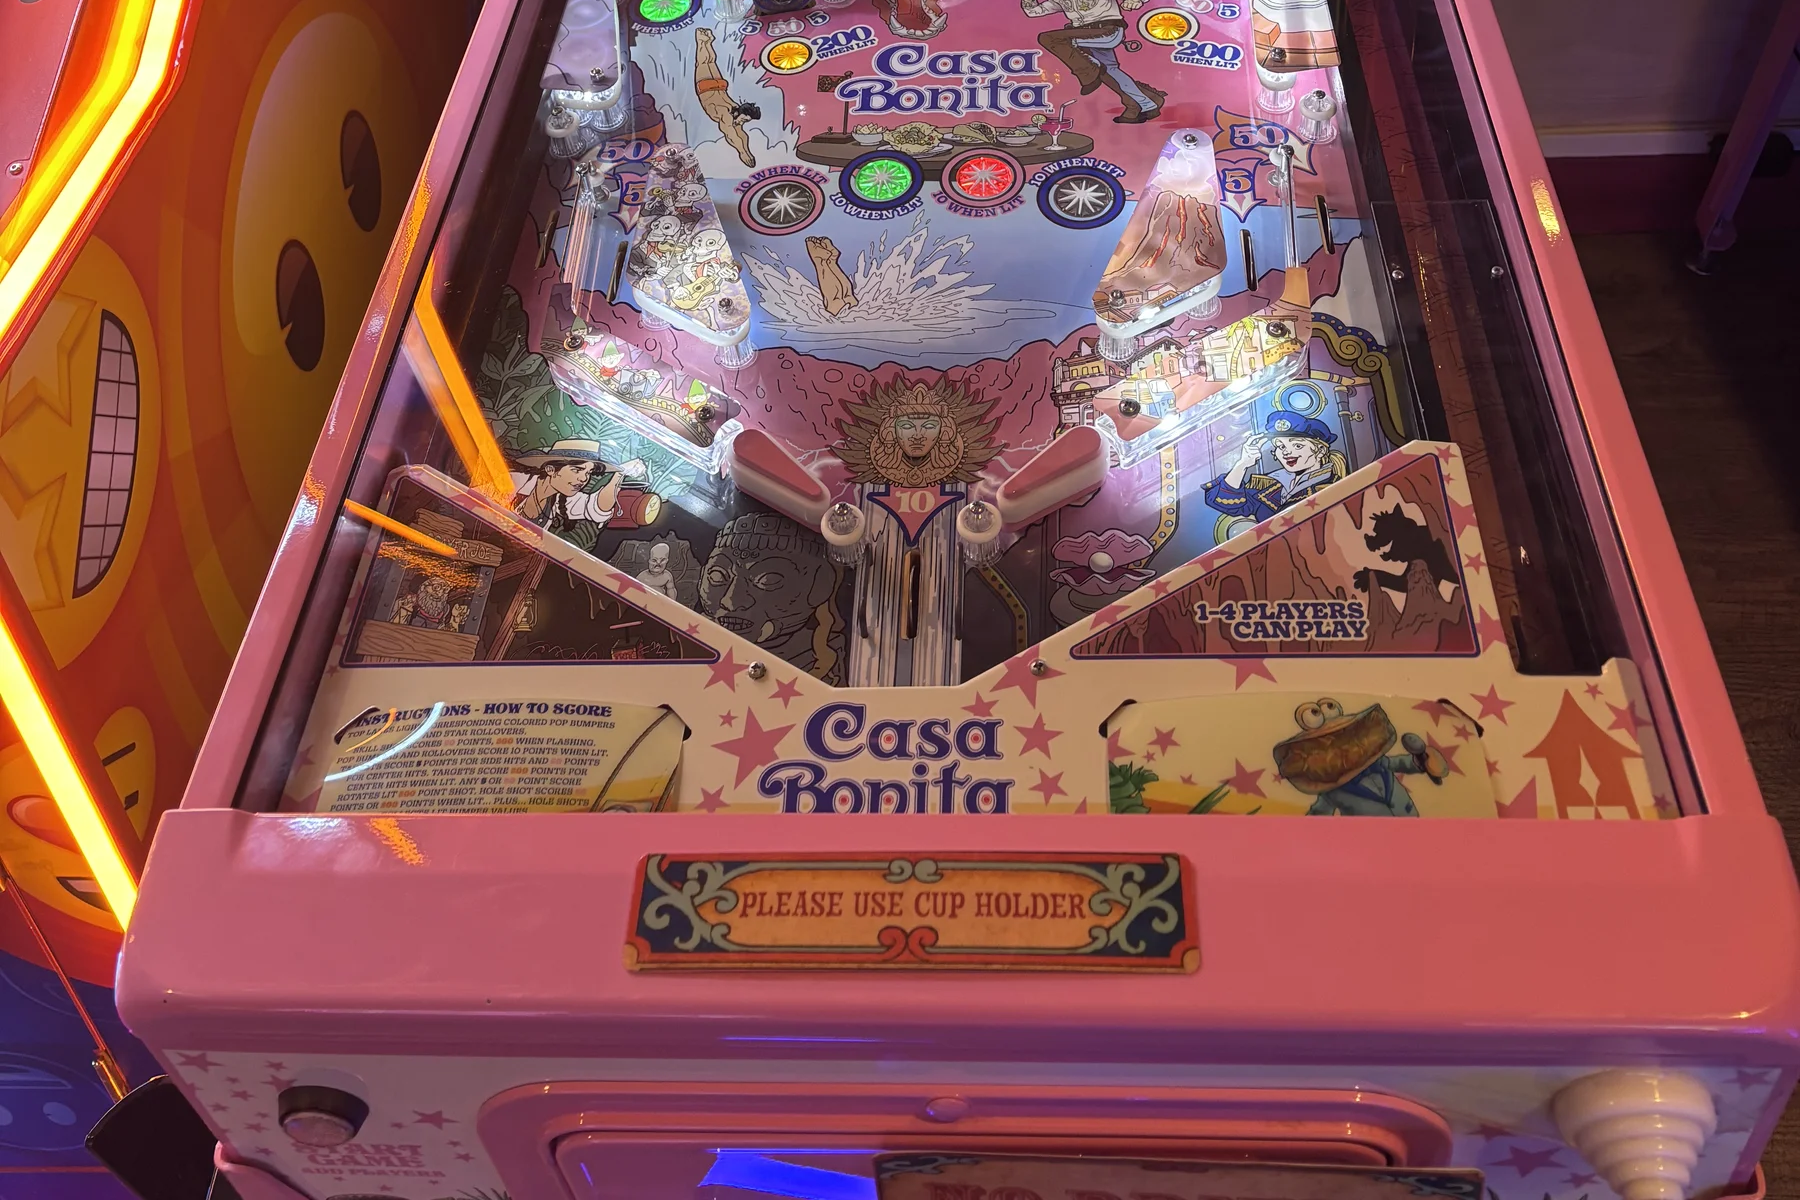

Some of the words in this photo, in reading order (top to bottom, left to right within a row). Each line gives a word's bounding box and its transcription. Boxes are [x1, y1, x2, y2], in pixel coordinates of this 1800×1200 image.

[807, 12, 829, 26] 5
[1217, 3, 1241, 18] 5
[631, 21, 670, 35] WHEN
[670, 17, 695, 32] LIT
[740, 19, 762, 34] 5
[768, 19, 805, 36] 50
[811, 26, 875, 53] 200
[816, 45, 858, 61] WHEN
[855, 38, 877, 52] LIT
[874, 44, 1041, 77] Casa
[1175, 40, 1242, 61] 200
[1173, 54, 1214, 66] WHEN
[1215, 59, 1240, 69] LIT
[836, 75, 1051, 116] Bonita
[1231, 125, 1288, 148] 50
[598, 140, 652, 162] 50
[736, 181, 752, 194] 10
[752, 165, 801, 181] WHEN
[802, 169, 829, 186] LIT
[1030, 173, 1045, 187] 10
[1044, 158, 1095, 174] WHEN
[1098, 160, 1125, 179] LIT
[1224, 168, 1252, 193] 5
[622, 182, 648, 207] 5
[932, 191, 946, 205] 10
[949, 202, 997, 217] WHEN
[999, 196, 1025, 214] LIT
[831, 192, 847, 207] 10
[846, 204, 894, 220] WHEN
[895, 197, 922, 217] LIT
[896, 491, 935, 513] 10
[470, 544, 492, 560] JOE
[1195, 602, 1237, 623] 1-4
[1241, 602, 1365, 623] PLAYERS
[1233, 621, 1296, 640] CAN
[1297, 620, 1368, 640] PLAY
[355, 704, 471, 727] INSTRUCTONS
[483, 703, 523, 714] HOW
[526, 703, 549, 714] TO
[552, 703, 613, 717] SCORE
[347, 730, 365, 738] TOP
[432, 719, 502, 729] ORRESPONDING
[549, 719, 568, 727] POP
[570, 720, 616, 729] BUMPERS
[443, 729, 468, 737] STAR
[804, 702, 1004, 762] Casa
[336, 757, 355, 765] POP
[400, 751, 420, 759] AND
[421, 749, 476, 757] ROLLOVERS
[522, 747, 558, 755] POINTS
[560, 748, 589, 756] WHEN
[384, 760, 414, 769] SCORE
[423, 757, 458, 767] POINTS
[460, 757, 478, 765] FOR
[480, 757, 503, 765] SIDE
[528, 757, 549, 765] AND
[564, 758, 601, 767] POINTS
[366, 771, 403, 780] CENTER
[432, 767, 475, 776] TARGETS
[477, 767, 509, 775] SCORE
[530, 767, 567, 776] POINTS
[568, 768, 588, 776] FOR
[337, 793, 380, 802] ROTATES
[381, 791, 397, 799] LIT
[418, 789, 448, 797] POINT
[479, 787, 504, 795] HOLE
[505, 787, 534, 795] SHOT
[347, 783, 384, 792] CENTER
[385, 781, 409, 789] HITS
[410, 780, 438, 788] WHEN
[517, 777, 548, 785] POINT
[549, 778, 582, 786] SCORE
[757, 760, 1015, 814] Bonita
[330, 803, 365, 812] POINTS
[366, 802, 379, 810] OR
[400, 800, 435, 808] POINTS
[437, 798, 466, 807] WHEN
[528, 797, 554, 806] HOLE
[556, 798, 590, 807] SHOTS
[740, 890, 844, 918] PLEASE
[853, 890, 905, 918] USE
[914, 891, 966, 919] CUP
[974, 891, 1087, 920] HOLDER
[302, 1167, 344, 1175] ADD
[307, 1154, 426, 1168] GAME
